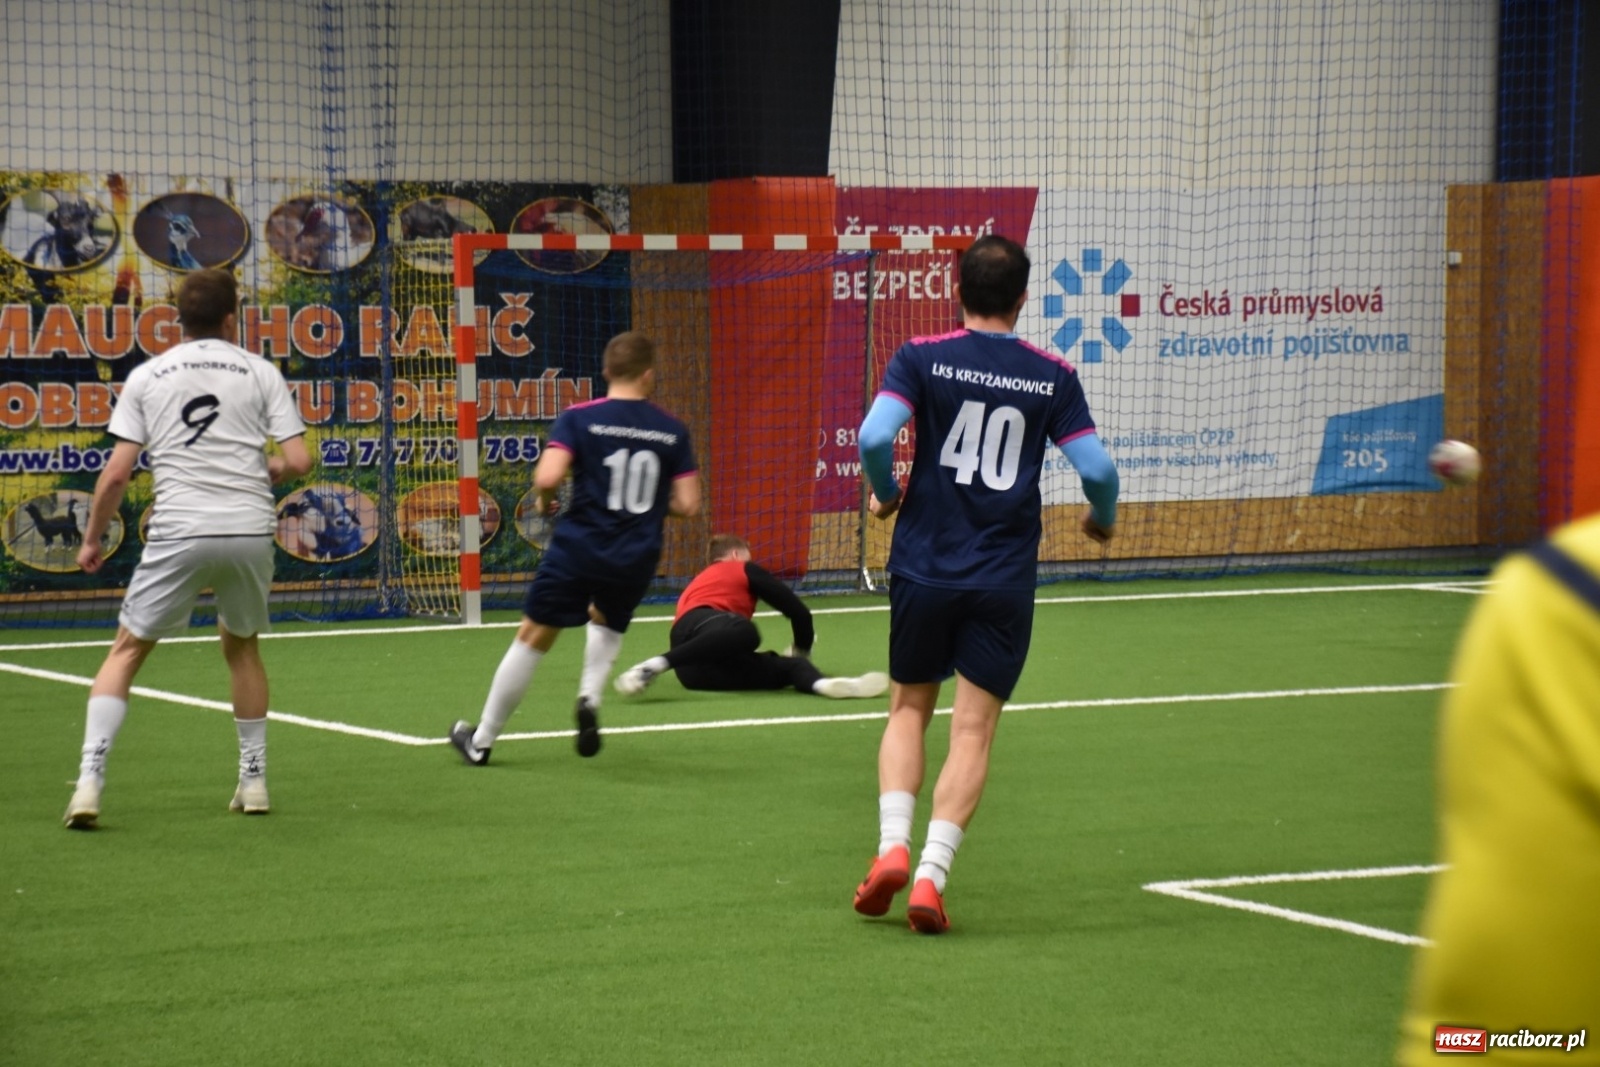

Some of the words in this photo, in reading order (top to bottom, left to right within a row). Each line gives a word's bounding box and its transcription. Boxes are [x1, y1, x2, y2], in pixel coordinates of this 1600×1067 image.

[1159, 284, 1231, 317] Česká
[1242, 285, 1384, 321] průmyslová
[1158, 329, 1274, 358] zdravotní
[1283, 327, 1411, 361] pojišťovna
[154, 365, 177, 379] LKS
[182, 361, 250, 376] TWORKÓW
[932, 362, 953, 379] LKS
[955, 368, 1056, 396] KRZYŻANOWICE
[181, 394, 220, 447] 9
[483, 436, 541, 464] 785
[939, 399, 1026, 491] 40
[1343, 448, 1388, 473] 205
[602, 448, 661, 514] 10
